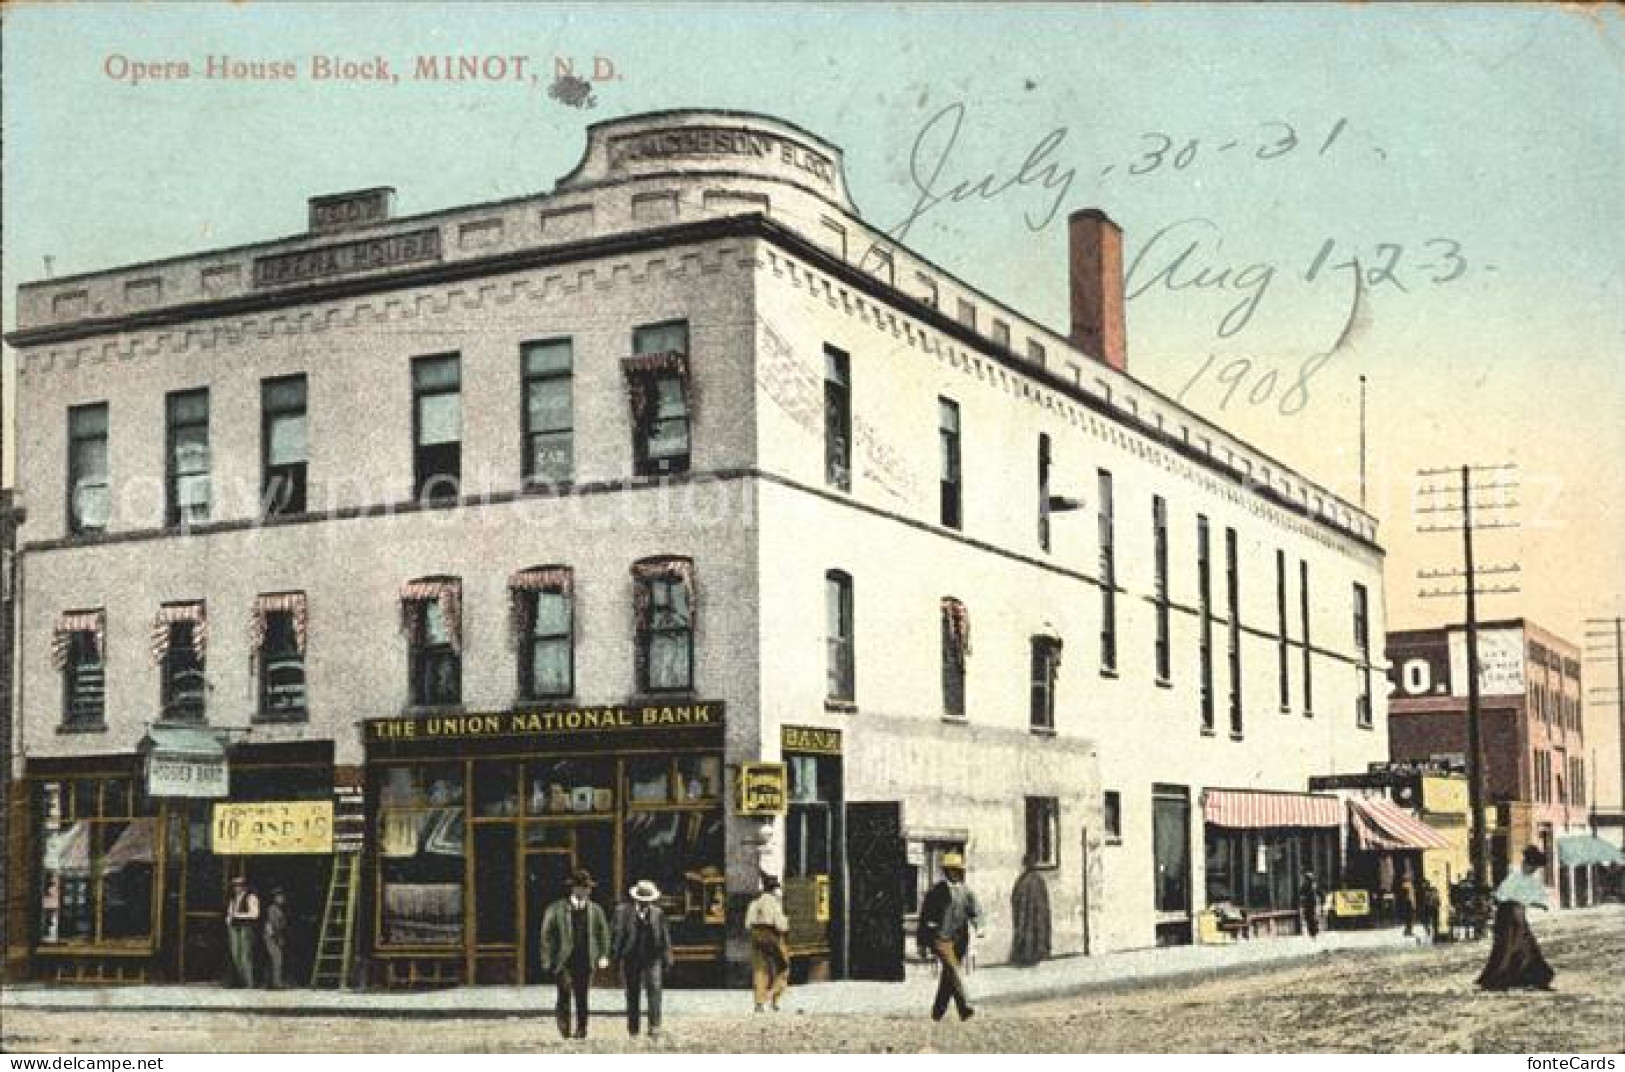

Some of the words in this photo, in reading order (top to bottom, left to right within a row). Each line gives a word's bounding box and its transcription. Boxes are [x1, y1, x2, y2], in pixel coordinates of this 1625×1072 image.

[104, 54, 190, 86] Opera
[206, 55, 297, 81] House
[311, 55, 400, 84] Block,
[413, 55, 537, 85] MINOT,
[1124, 218, 1277, 338] Aug
[374, 720, 416, 738] THE
[427, 715, 499, 735] UNION
[512, 707, 632, 731] NATIONAL
[642, 703, 709, 724] BANK
[786, 728, 838, 749] BANK
